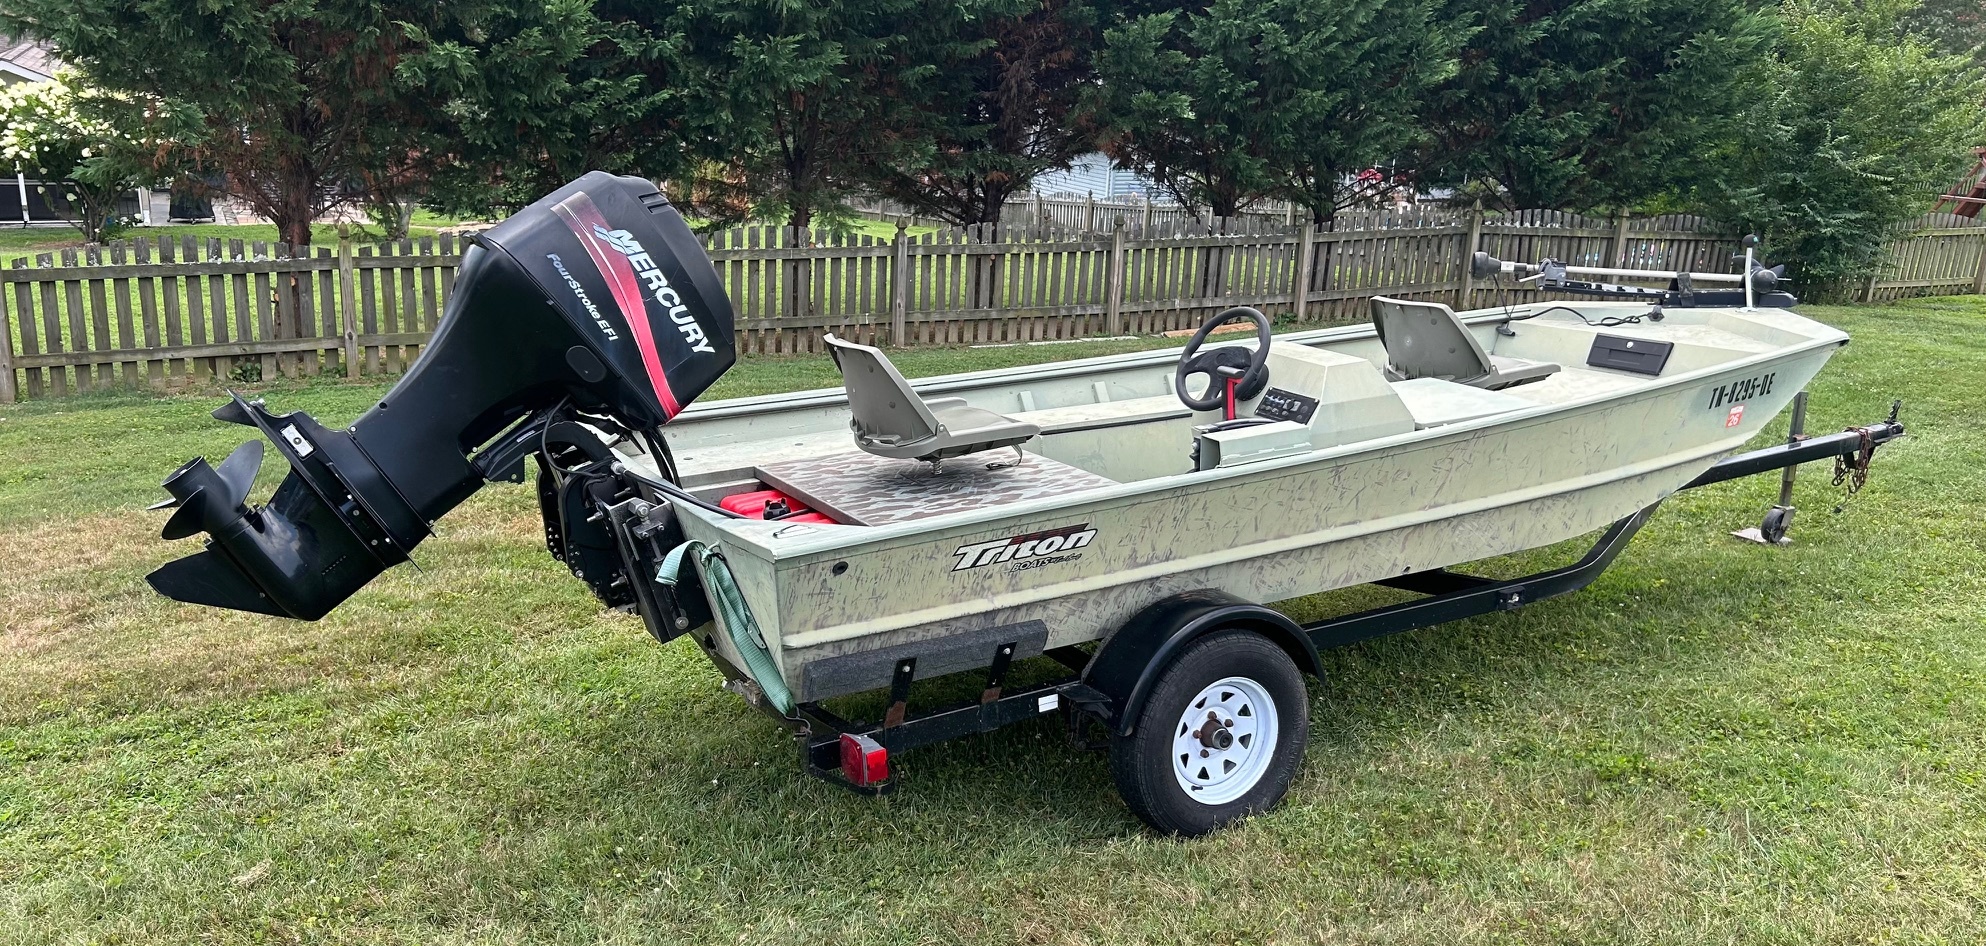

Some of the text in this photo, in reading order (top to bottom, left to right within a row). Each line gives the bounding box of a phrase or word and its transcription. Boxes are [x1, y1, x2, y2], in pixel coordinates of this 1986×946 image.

[546, 253, 619, 341] FourStroke EFI
[596, 226, 715, 354] MERCURY
[1727, 413, 1741, 427] 26
[951, 528, 1098, 572] Triton
[1010, 556, 1050, 573] BOATS
